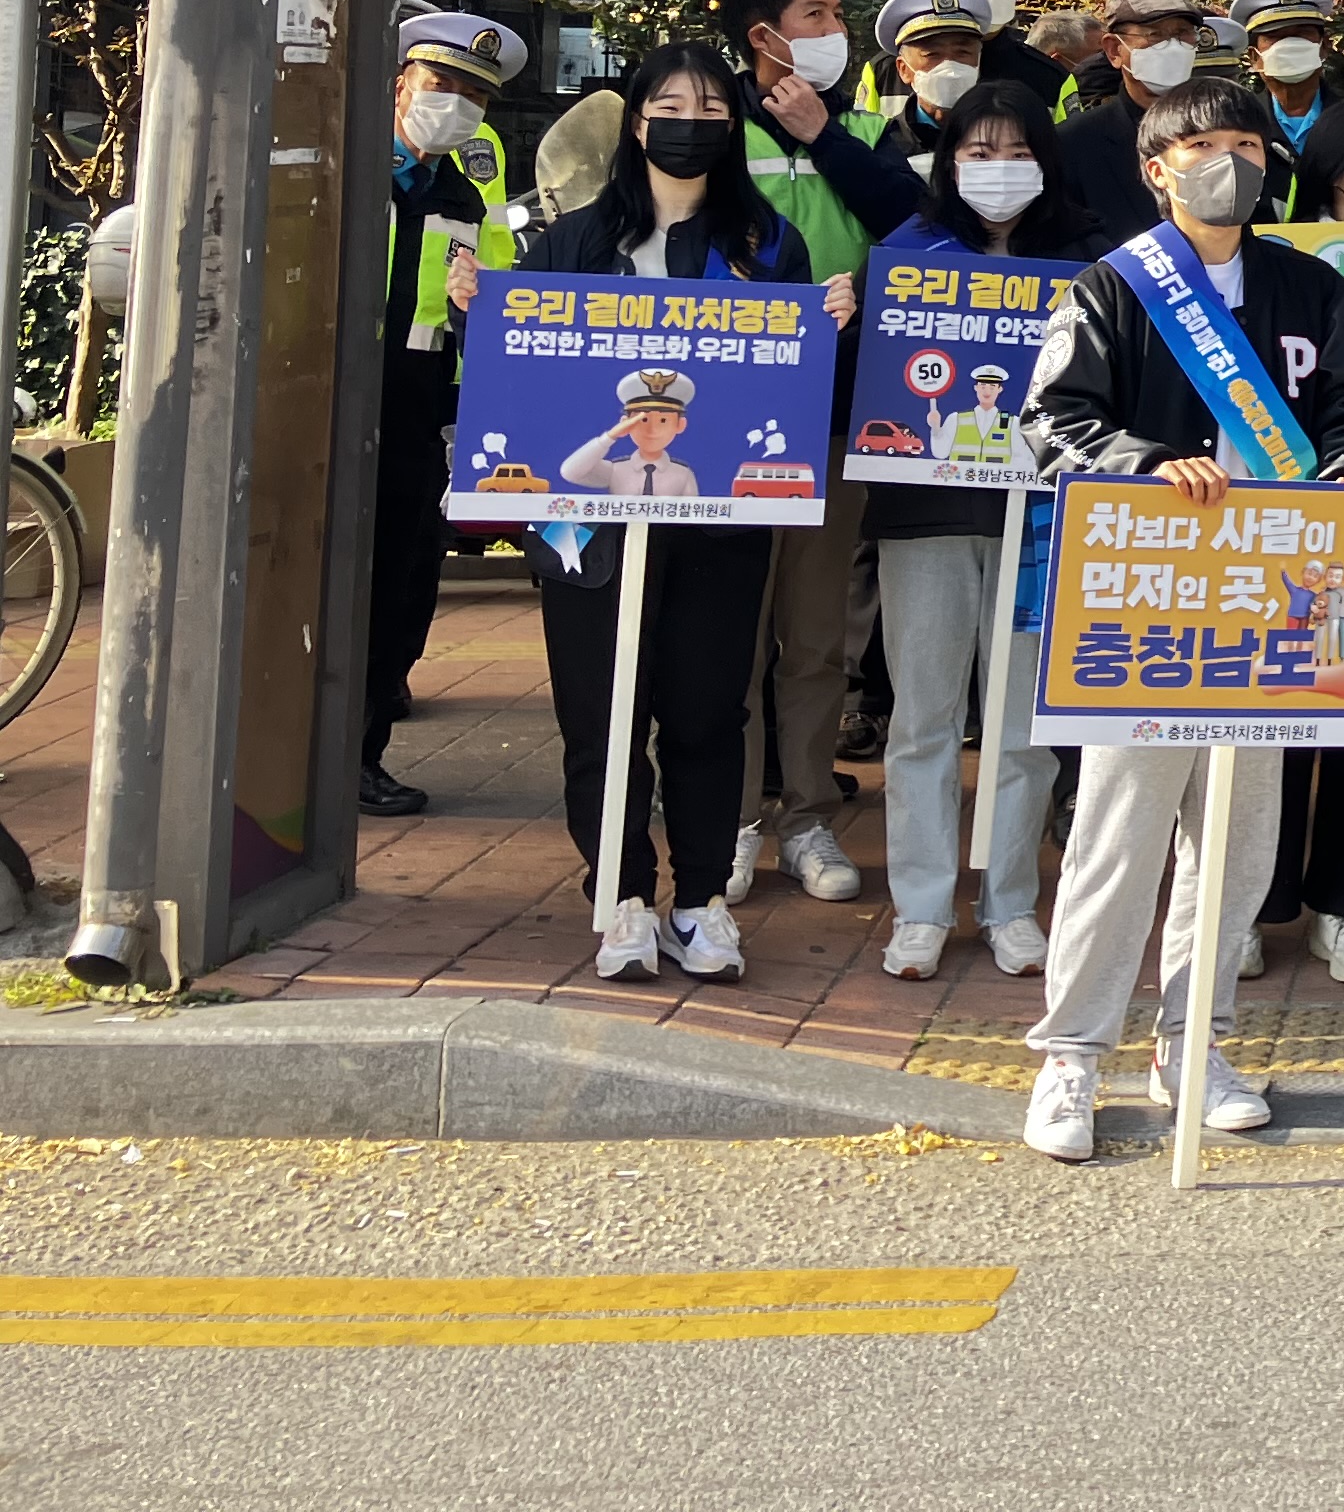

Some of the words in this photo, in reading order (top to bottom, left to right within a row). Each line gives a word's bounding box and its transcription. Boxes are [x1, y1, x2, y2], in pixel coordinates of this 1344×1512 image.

[884, 266, 961, 306] 우리
[968, 273, 1039, 310] 곁에
[503, 288, 577, 326] 우리
[584, 292, 655, 330] 곁에
[660, 297, 807, 339] 자치경찰,
[877, 309, 988, 343] 우리곁에
[504, 329, 585, 358] 안전한
[587, 333, 692, 361] 교통문화
[695, 338, 746, 364] 우리
[751, 340, 801, 366] 곁에
[1175, 301, 1241, 381] 행복한
[918, 362, 942, 380] 50
[1280, 335, 1318, 399] P
[582, 500, 732, 519] 충청남도자치경찰위원회
[1082, 501, 1202, 552] 차보다
[1210, 507, 1337, 557] 사람이
[1080, 559, 1209, 613] 먼저인
[1217, 565, 1280, 621] 곳,
[1071, 622, 1316, 689] 충청남도
[1167, 722, 1319, 742] 충청남도자치경찰위원회
